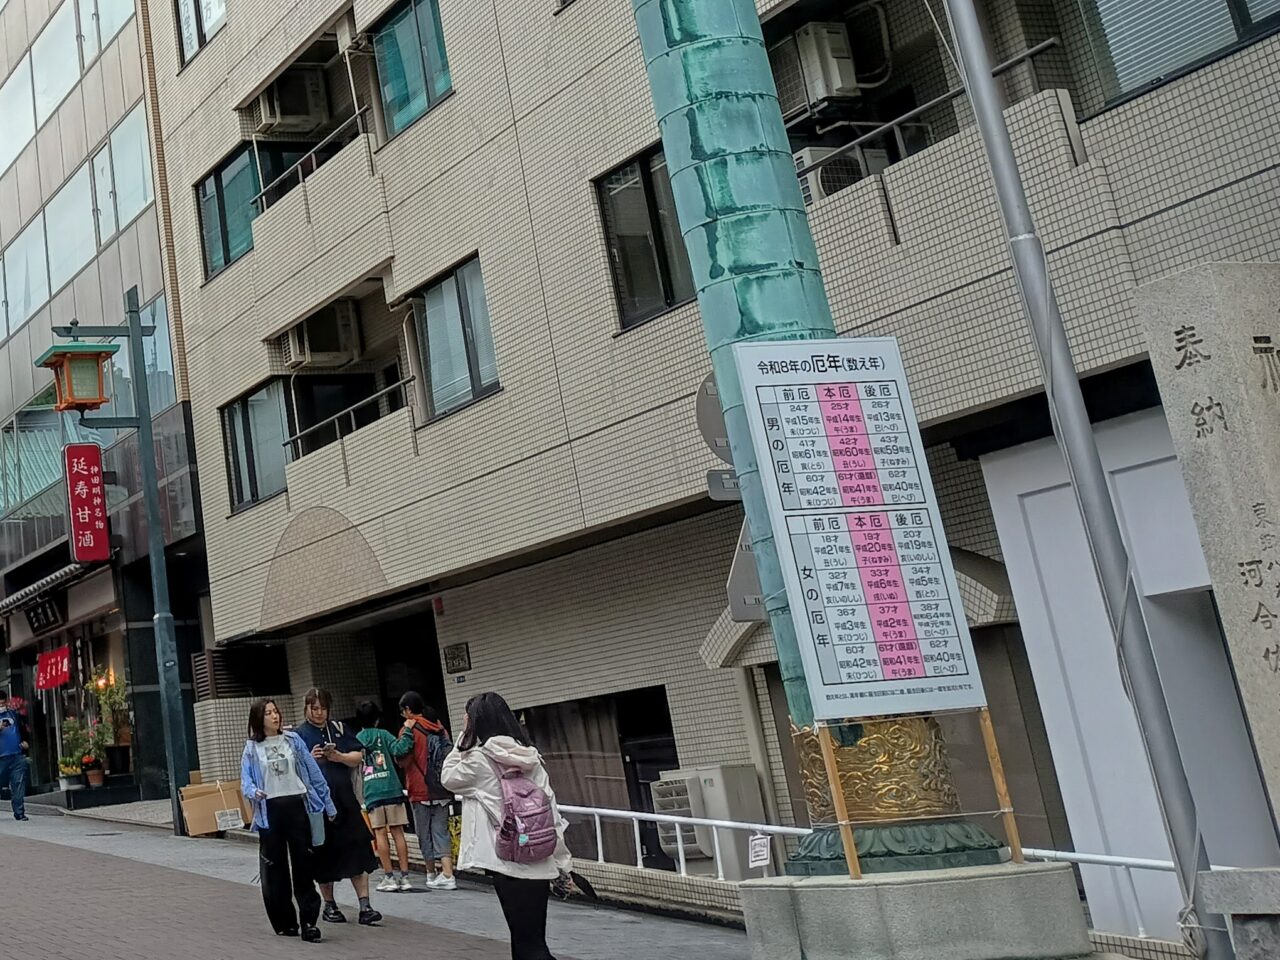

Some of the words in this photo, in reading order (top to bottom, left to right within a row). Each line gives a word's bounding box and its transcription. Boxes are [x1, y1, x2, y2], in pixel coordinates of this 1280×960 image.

[757, 354, 886, 374] 令和8年の厄年(数え年)
[783, 388, 810, 401] 前厄
[824, 386, 851, 399] 本厄
[864, 384, 892, 397] 後厄
[785, 415, 820, 426] 平成15年生
[826, 413, 862, 423] 平成14年生
[867, 412, 902, 422] 平成13年生
[840, 438, 858, 446] 42才
[880, 436, 898, 444] 43才
[792, 449, 829, 459] 昭和61年生
[833, 447, 871, 457] 昭和60年生
[874, 445, 911, 455] 昭和59年生
[767, 418, 794, 495] 男の厄年
[806, 474, 825, 482] 60才
[889, 470, 907, 478] 62才
[800, 485, 838, 496] 昭和42年生
[843, 483, 879, 493] 昭和41年生
[883, 481, 920, 491] 昭和40年生
[71, 457, 94, 548] 延寿甘酒
[90, 465, 104, 530] 神田明神名物
[812, 517, 840, 530] 前厄
[854, 515, 882, 528] 本厄
[896, 513, 924, 526] 後厄
[904, 530, 921, 538] 20才
[814, 544, 851, 554] 平成21年生
[856, 542, 894, 552] 平成20年生
[898, 540, 934, 550] 平成19年生
[870, 569, 890, 577] 33才
[912, 566, 931, 574] 34才
[828, 572, 848, 580] 32才
[909, 576, 940, 586] 平成5年生
[826, 581, 857, 591] 平成7年生
[868, 579, 900, 588] 平成6年生
[801, 566, 829, 647] 女の厄年
[879, 606, 898, 614] 37才
[921, 604, 940, 612] 38才
[837, 609, 856, 617] 36才
[834, 621, 867, 630] 平成3年生
[877, 618, 909, 628] 平成2年生
[918, 620, 951, 628] 平成元年生
[930, 640, 949, 648] 62才
[846, 646, 866, 654] 60才
[883, 655, 920, 666] 昭和41年生
[924, 652, 962, 662] 昭和40年生
[840, 658, 878, 668] 昭和42年生
